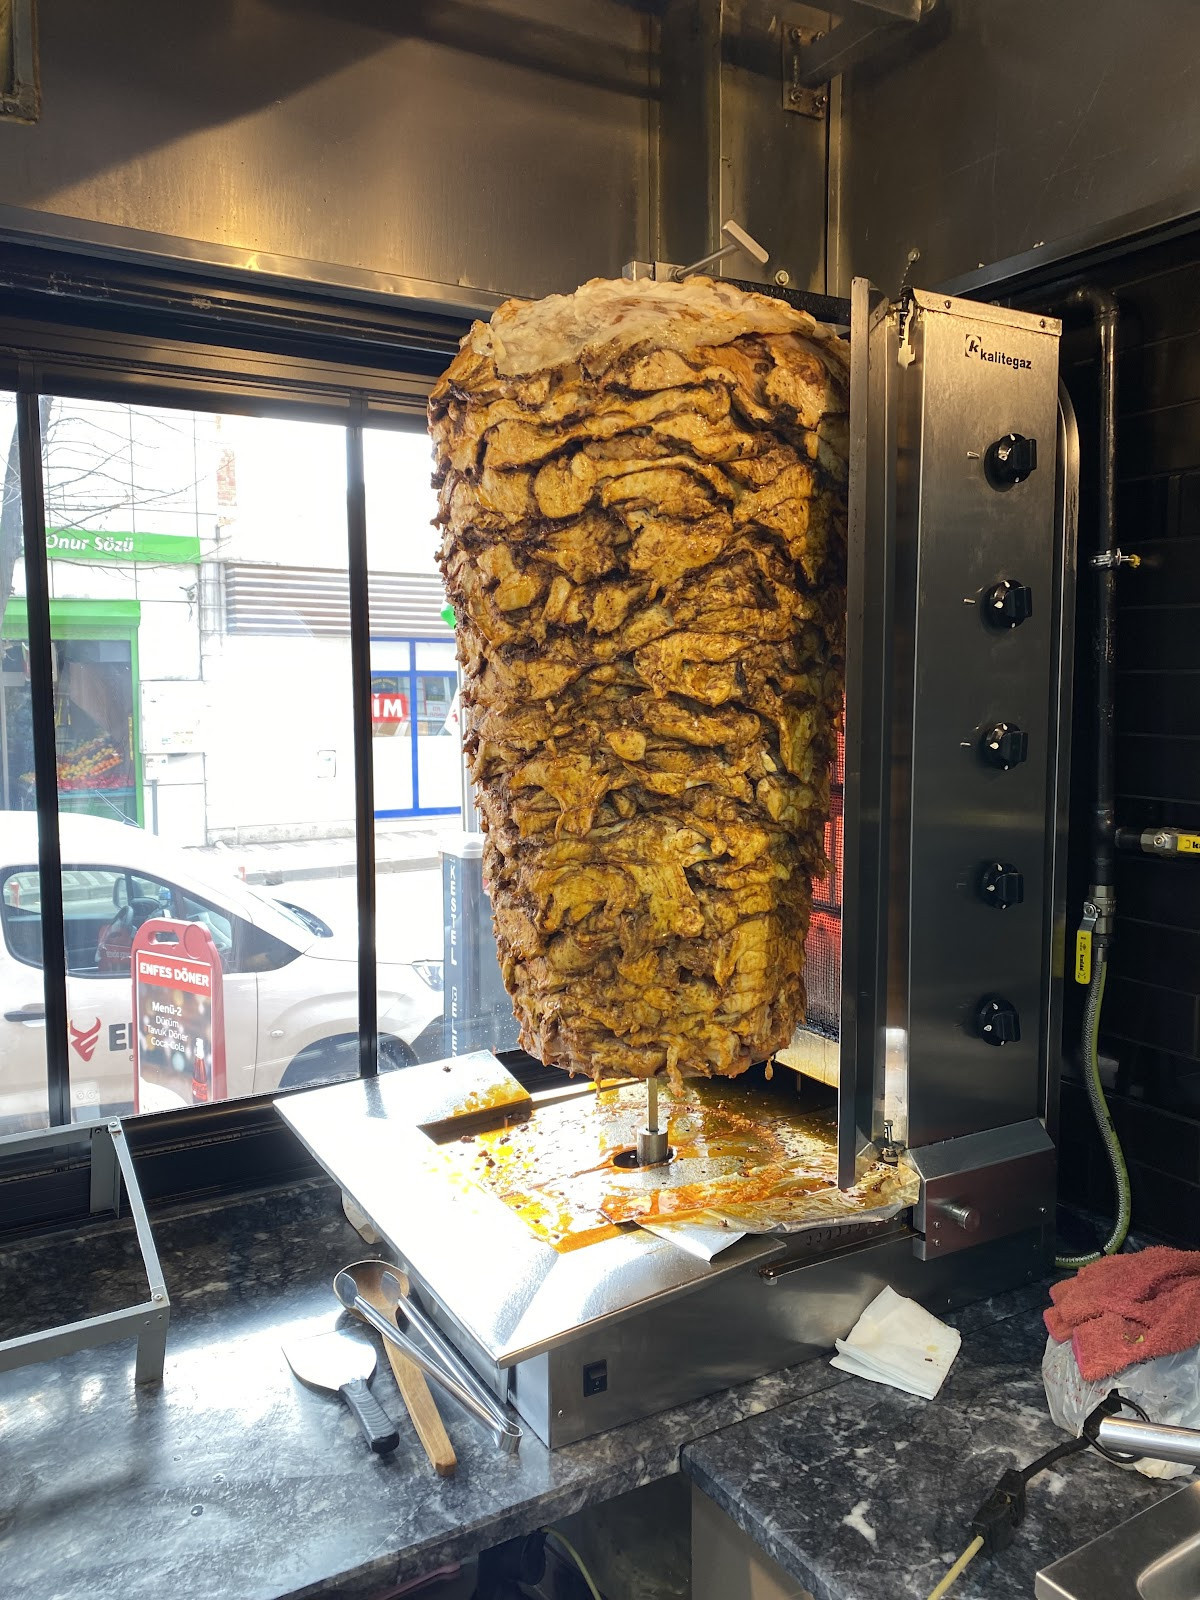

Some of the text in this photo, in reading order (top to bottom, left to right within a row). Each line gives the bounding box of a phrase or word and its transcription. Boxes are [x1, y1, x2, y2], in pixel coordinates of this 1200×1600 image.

[980, 348, 1032, 370] kalitegaz
[46, 534, 134, 552] Onur Sözü
[449, 864, 458, 966] KESTEL
[140, 962, 209, 987] ENFES DÖNER
[151, 1001, 183, 1016] Menü-2
[155, 1015, 179, 1028] Dürüm
[146, 1024, 189, 1042] Tavuk Döner
[150, 1037, 185, 1053] Coca-Cola
